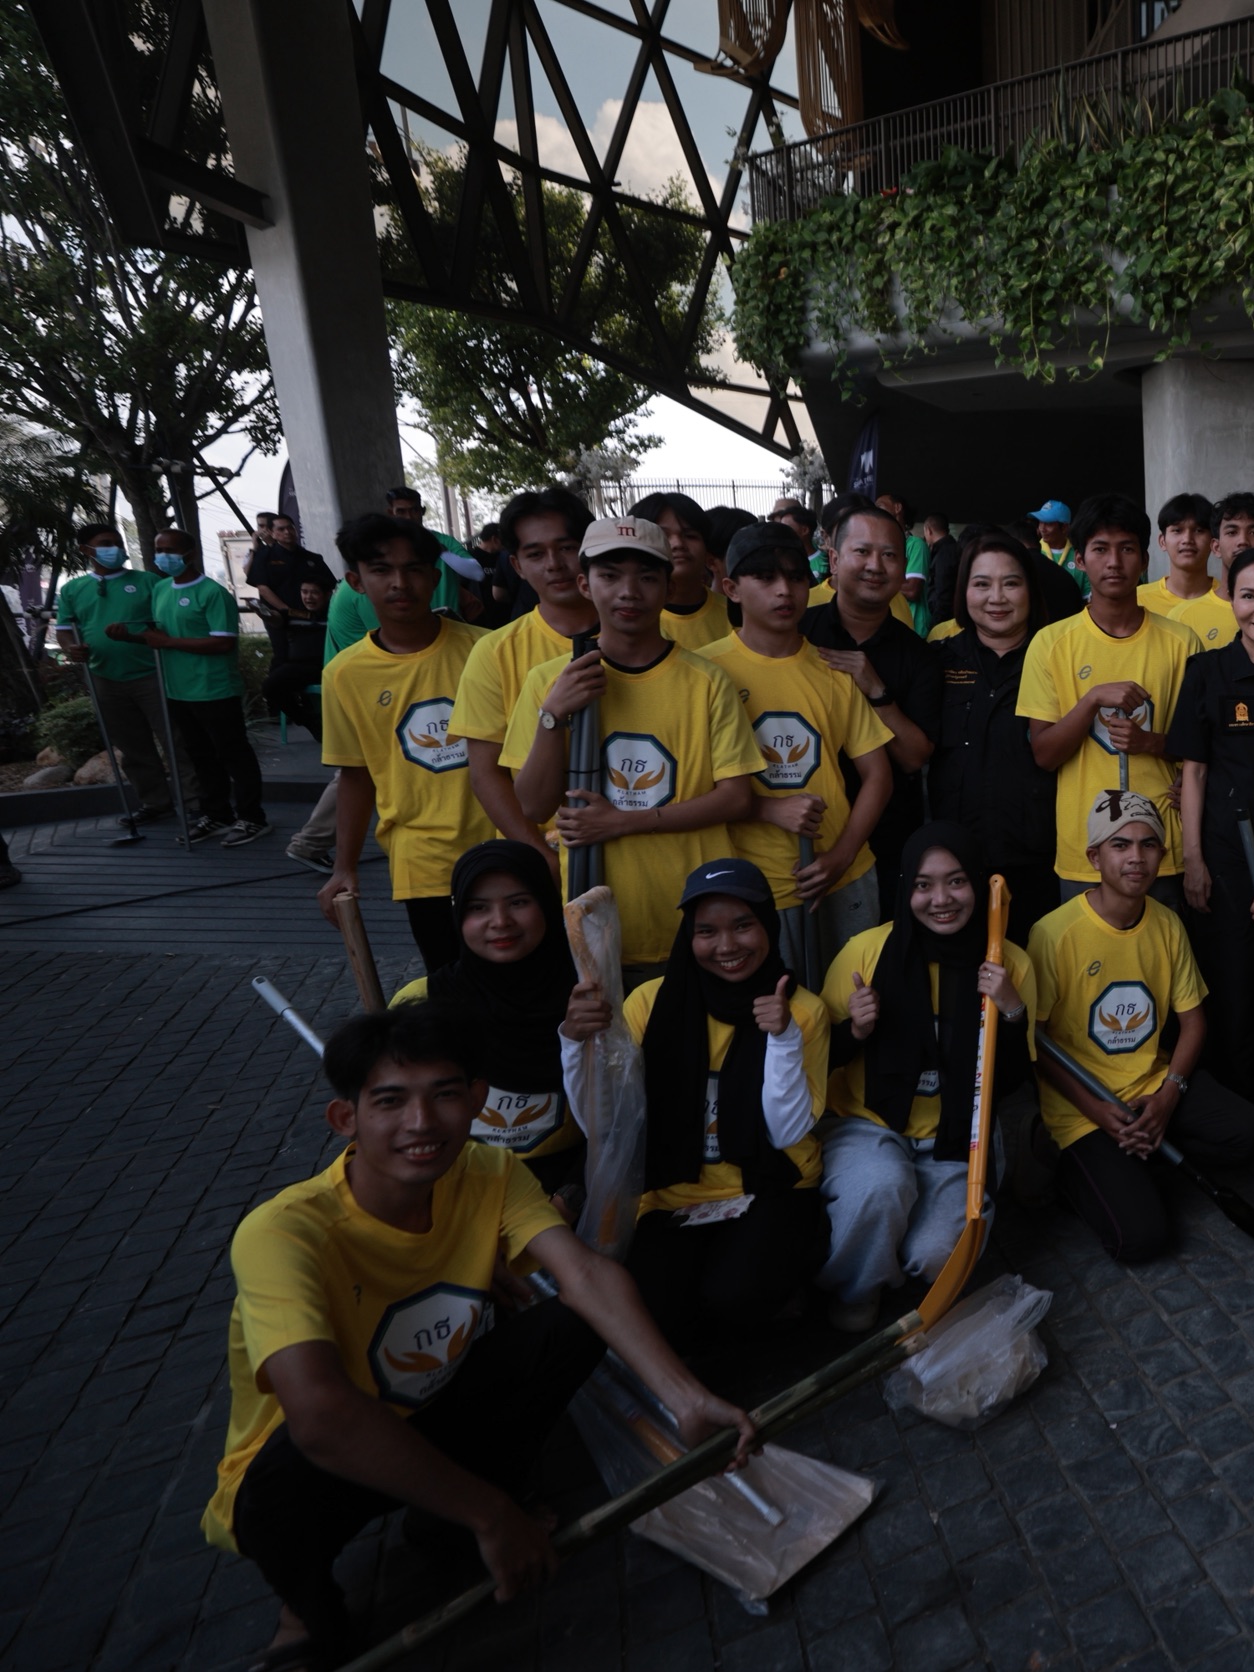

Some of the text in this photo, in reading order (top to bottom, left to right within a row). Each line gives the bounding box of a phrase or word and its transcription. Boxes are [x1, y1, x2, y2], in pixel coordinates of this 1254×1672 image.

[773, 734, 794, 748] กธ
[620, 758, 647, 773] กธ
[769, 769, 801, 779] กล้าธรรม
[1115, 1003, 1137, 1015] กธ
[497, 1094, 531, 1110] กธ
[414, 1316, 451, 1350] กธ
